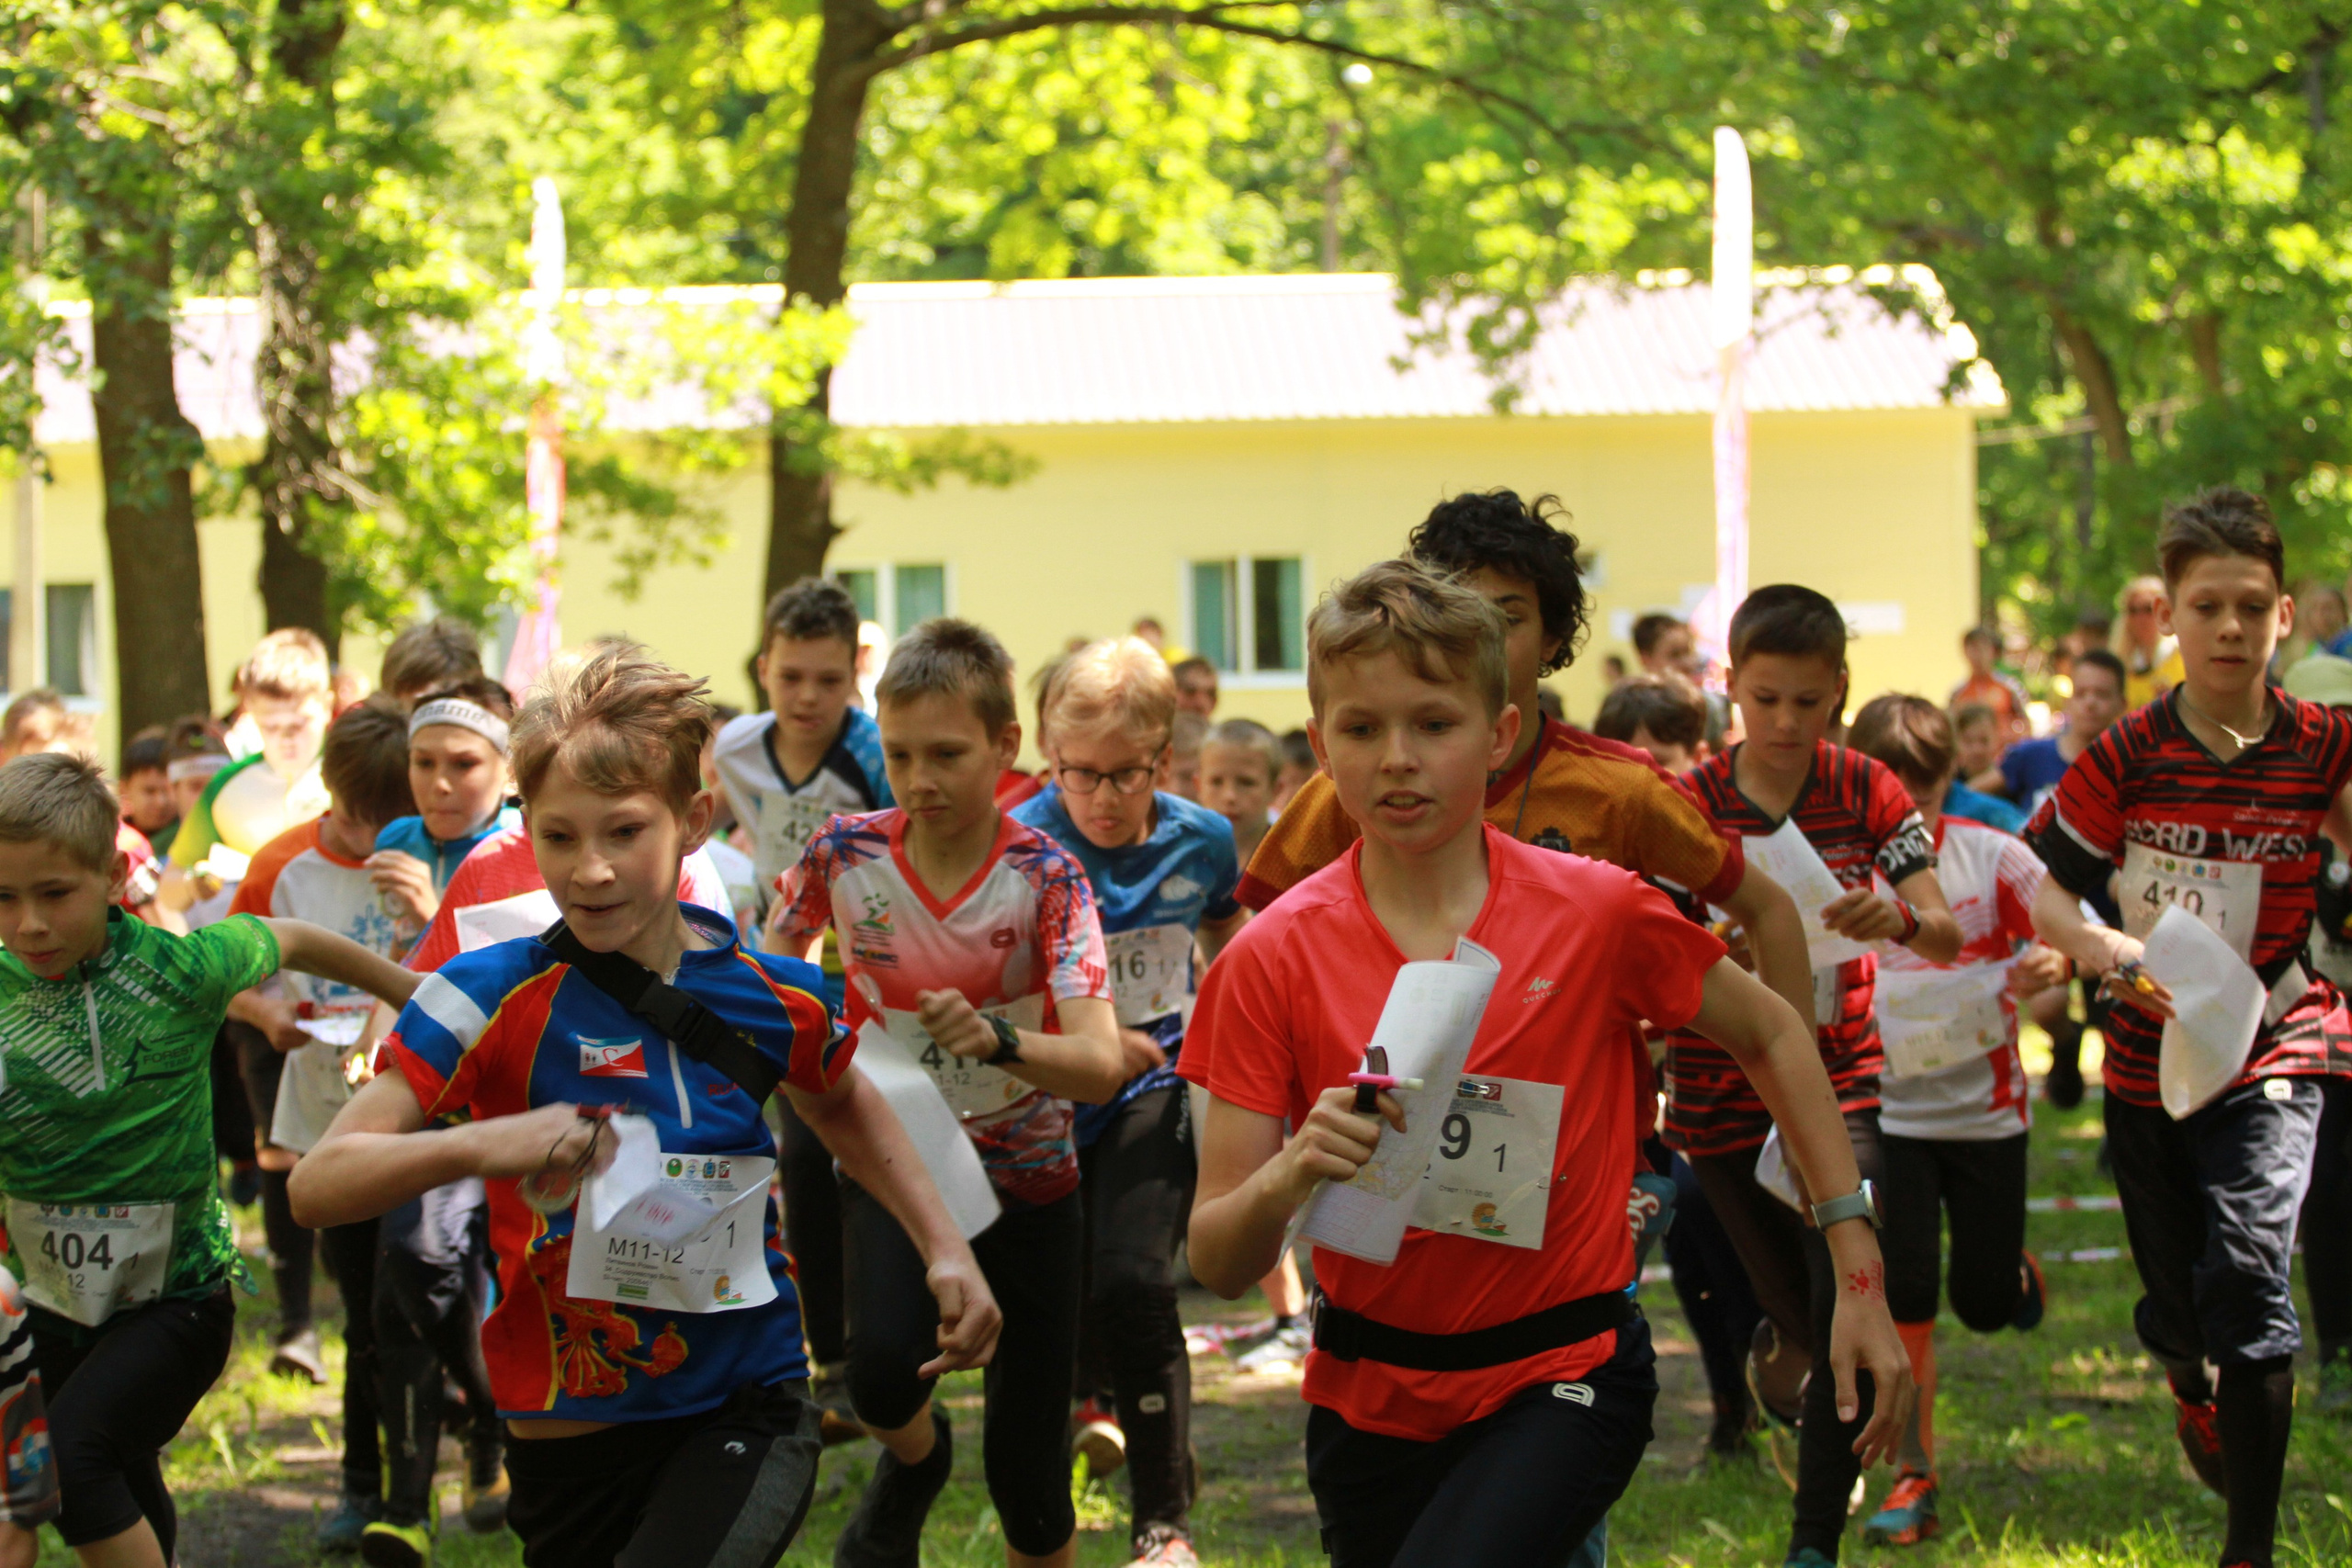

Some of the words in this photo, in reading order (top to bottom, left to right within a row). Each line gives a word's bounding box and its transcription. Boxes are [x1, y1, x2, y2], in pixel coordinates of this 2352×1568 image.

[782, 820, 813, 845] 42
[1109, 950, 1145, 983] 16
[142, 1043, 196, 1065] FOREST
[1493, 1143, 1507, 1173] 1
[727, 1219, 736, 1249] 1
[40, 1230, 114, 1271] 404
[607, 1236, 685, 1265] M11-12
